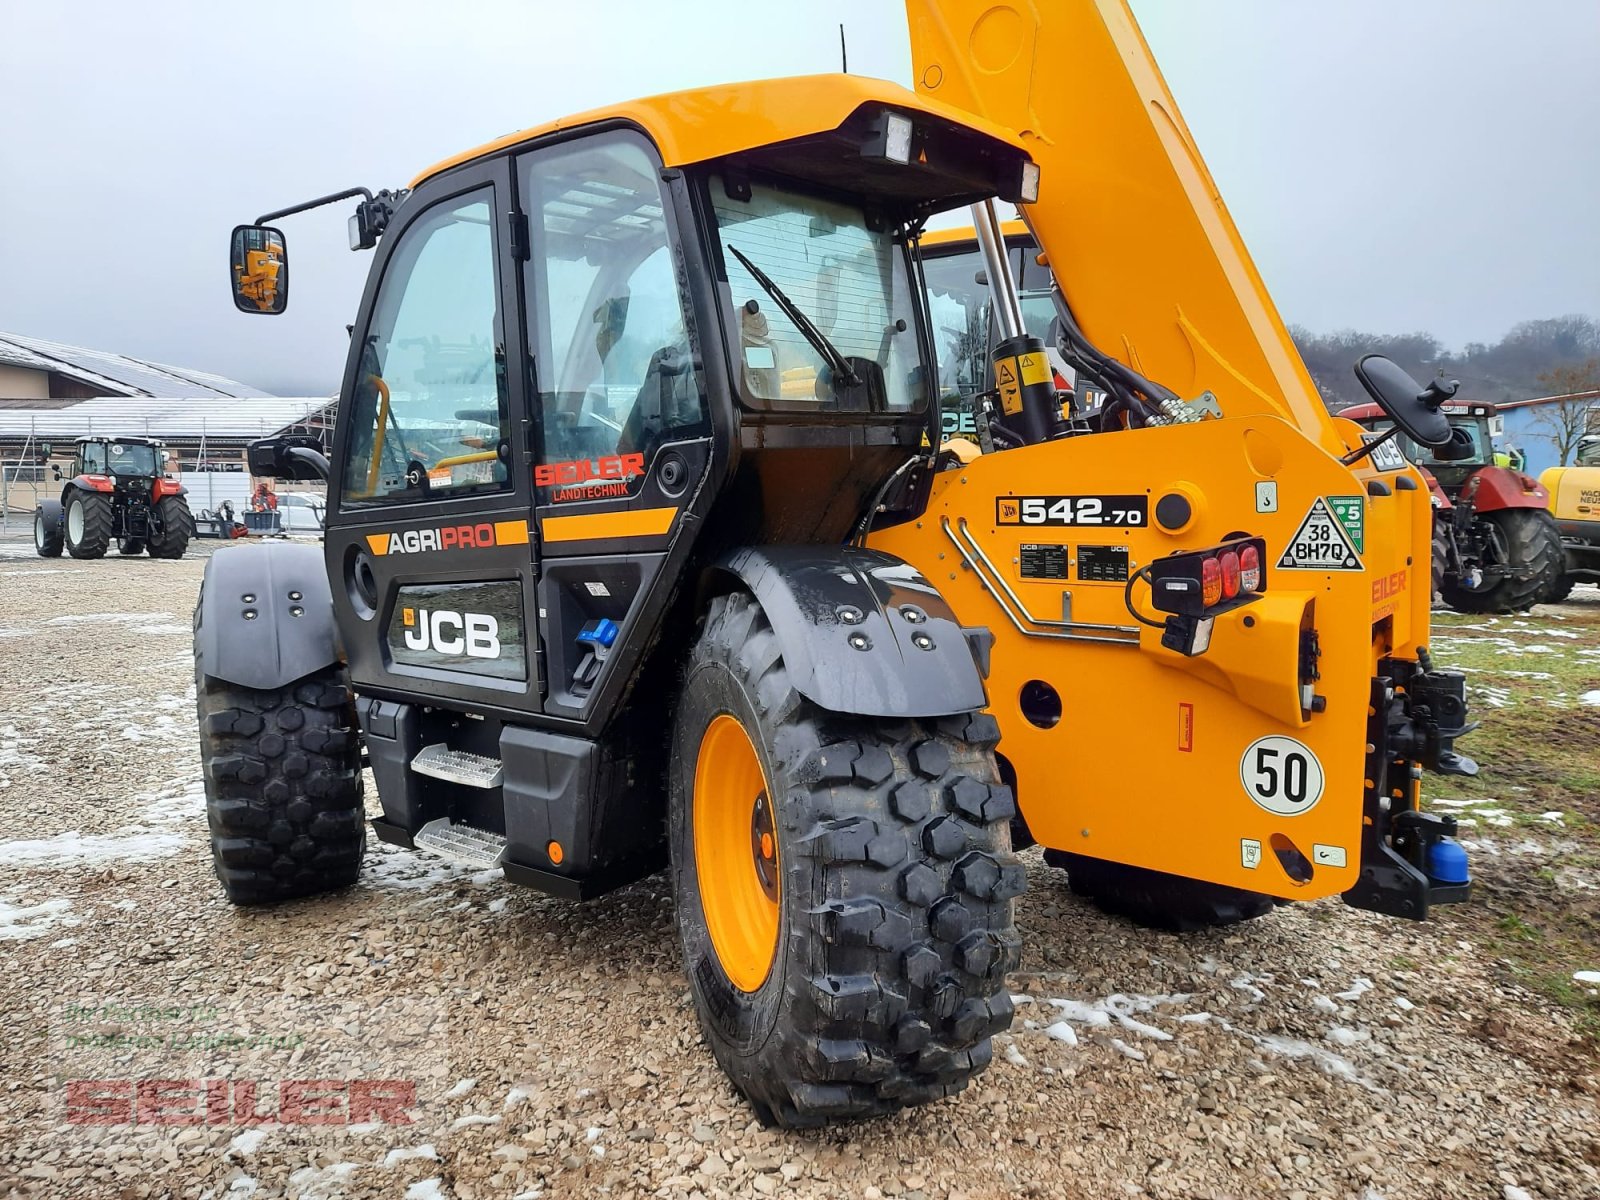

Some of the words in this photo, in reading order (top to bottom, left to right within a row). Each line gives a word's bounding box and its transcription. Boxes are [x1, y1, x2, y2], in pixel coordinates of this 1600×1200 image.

[535, 452, 646, 488] SEILER
[552, 482, 629, 502] LANDTECHNIK
[1347, 506, 1360, 520] 5
[1308, 524, 1330, 541] 38
[1295, 543, 1343, 560] BH7Q
[1371, 569, 1406, 604] EILER
[403, 608, 501, 660] JCB
[1255, 747, 1309, 803] 50
